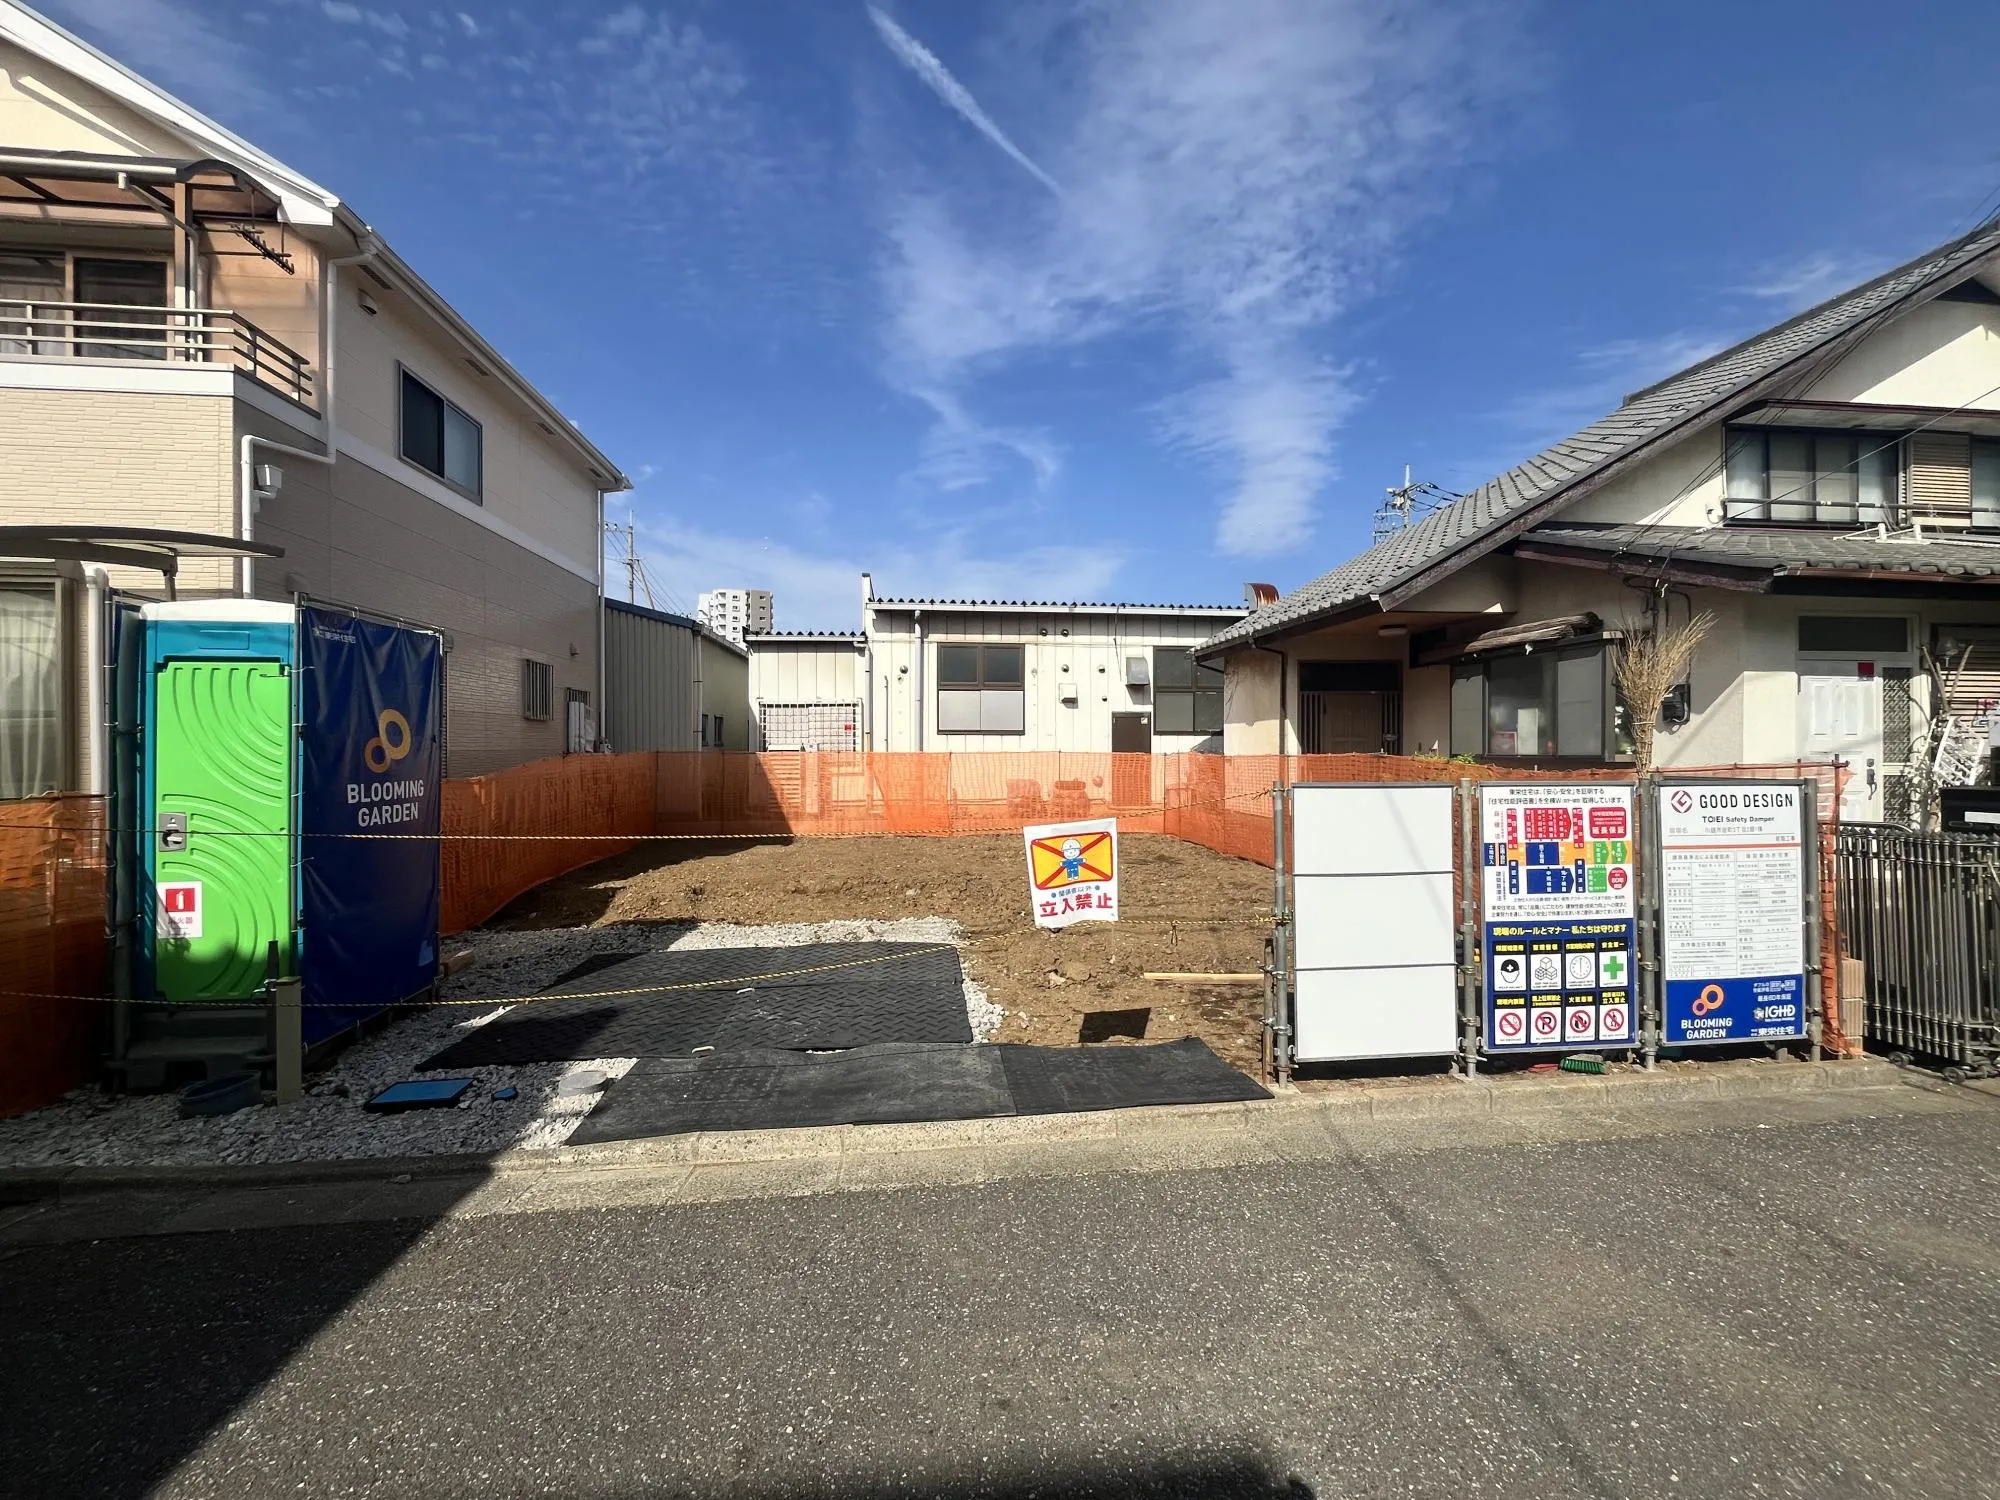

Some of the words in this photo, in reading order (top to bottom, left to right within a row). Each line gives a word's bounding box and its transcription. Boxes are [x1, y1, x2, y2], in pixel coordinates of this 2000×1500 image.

[347, 779, 424, 804] BLOOMING
[1699, 794, 1738, 809] GOOD
[1743, 793, 1793, 808] DESIGN
[358, 802, 419, 827] GARDEN
[1725, 815, 1748, 824] Safety
[1749, 815, 1775, 823] Damper
[1039, 893, 1113, 918] 立入禁止
[1493, 926, 1570, 936] 現場のルールとマナー
[1571, 924, 1627, 935] 私たちは守ります
[1681, 1017, 1733, 1029] BLOOMING
[1686, 1028, 1727, 1040] GARDEN
